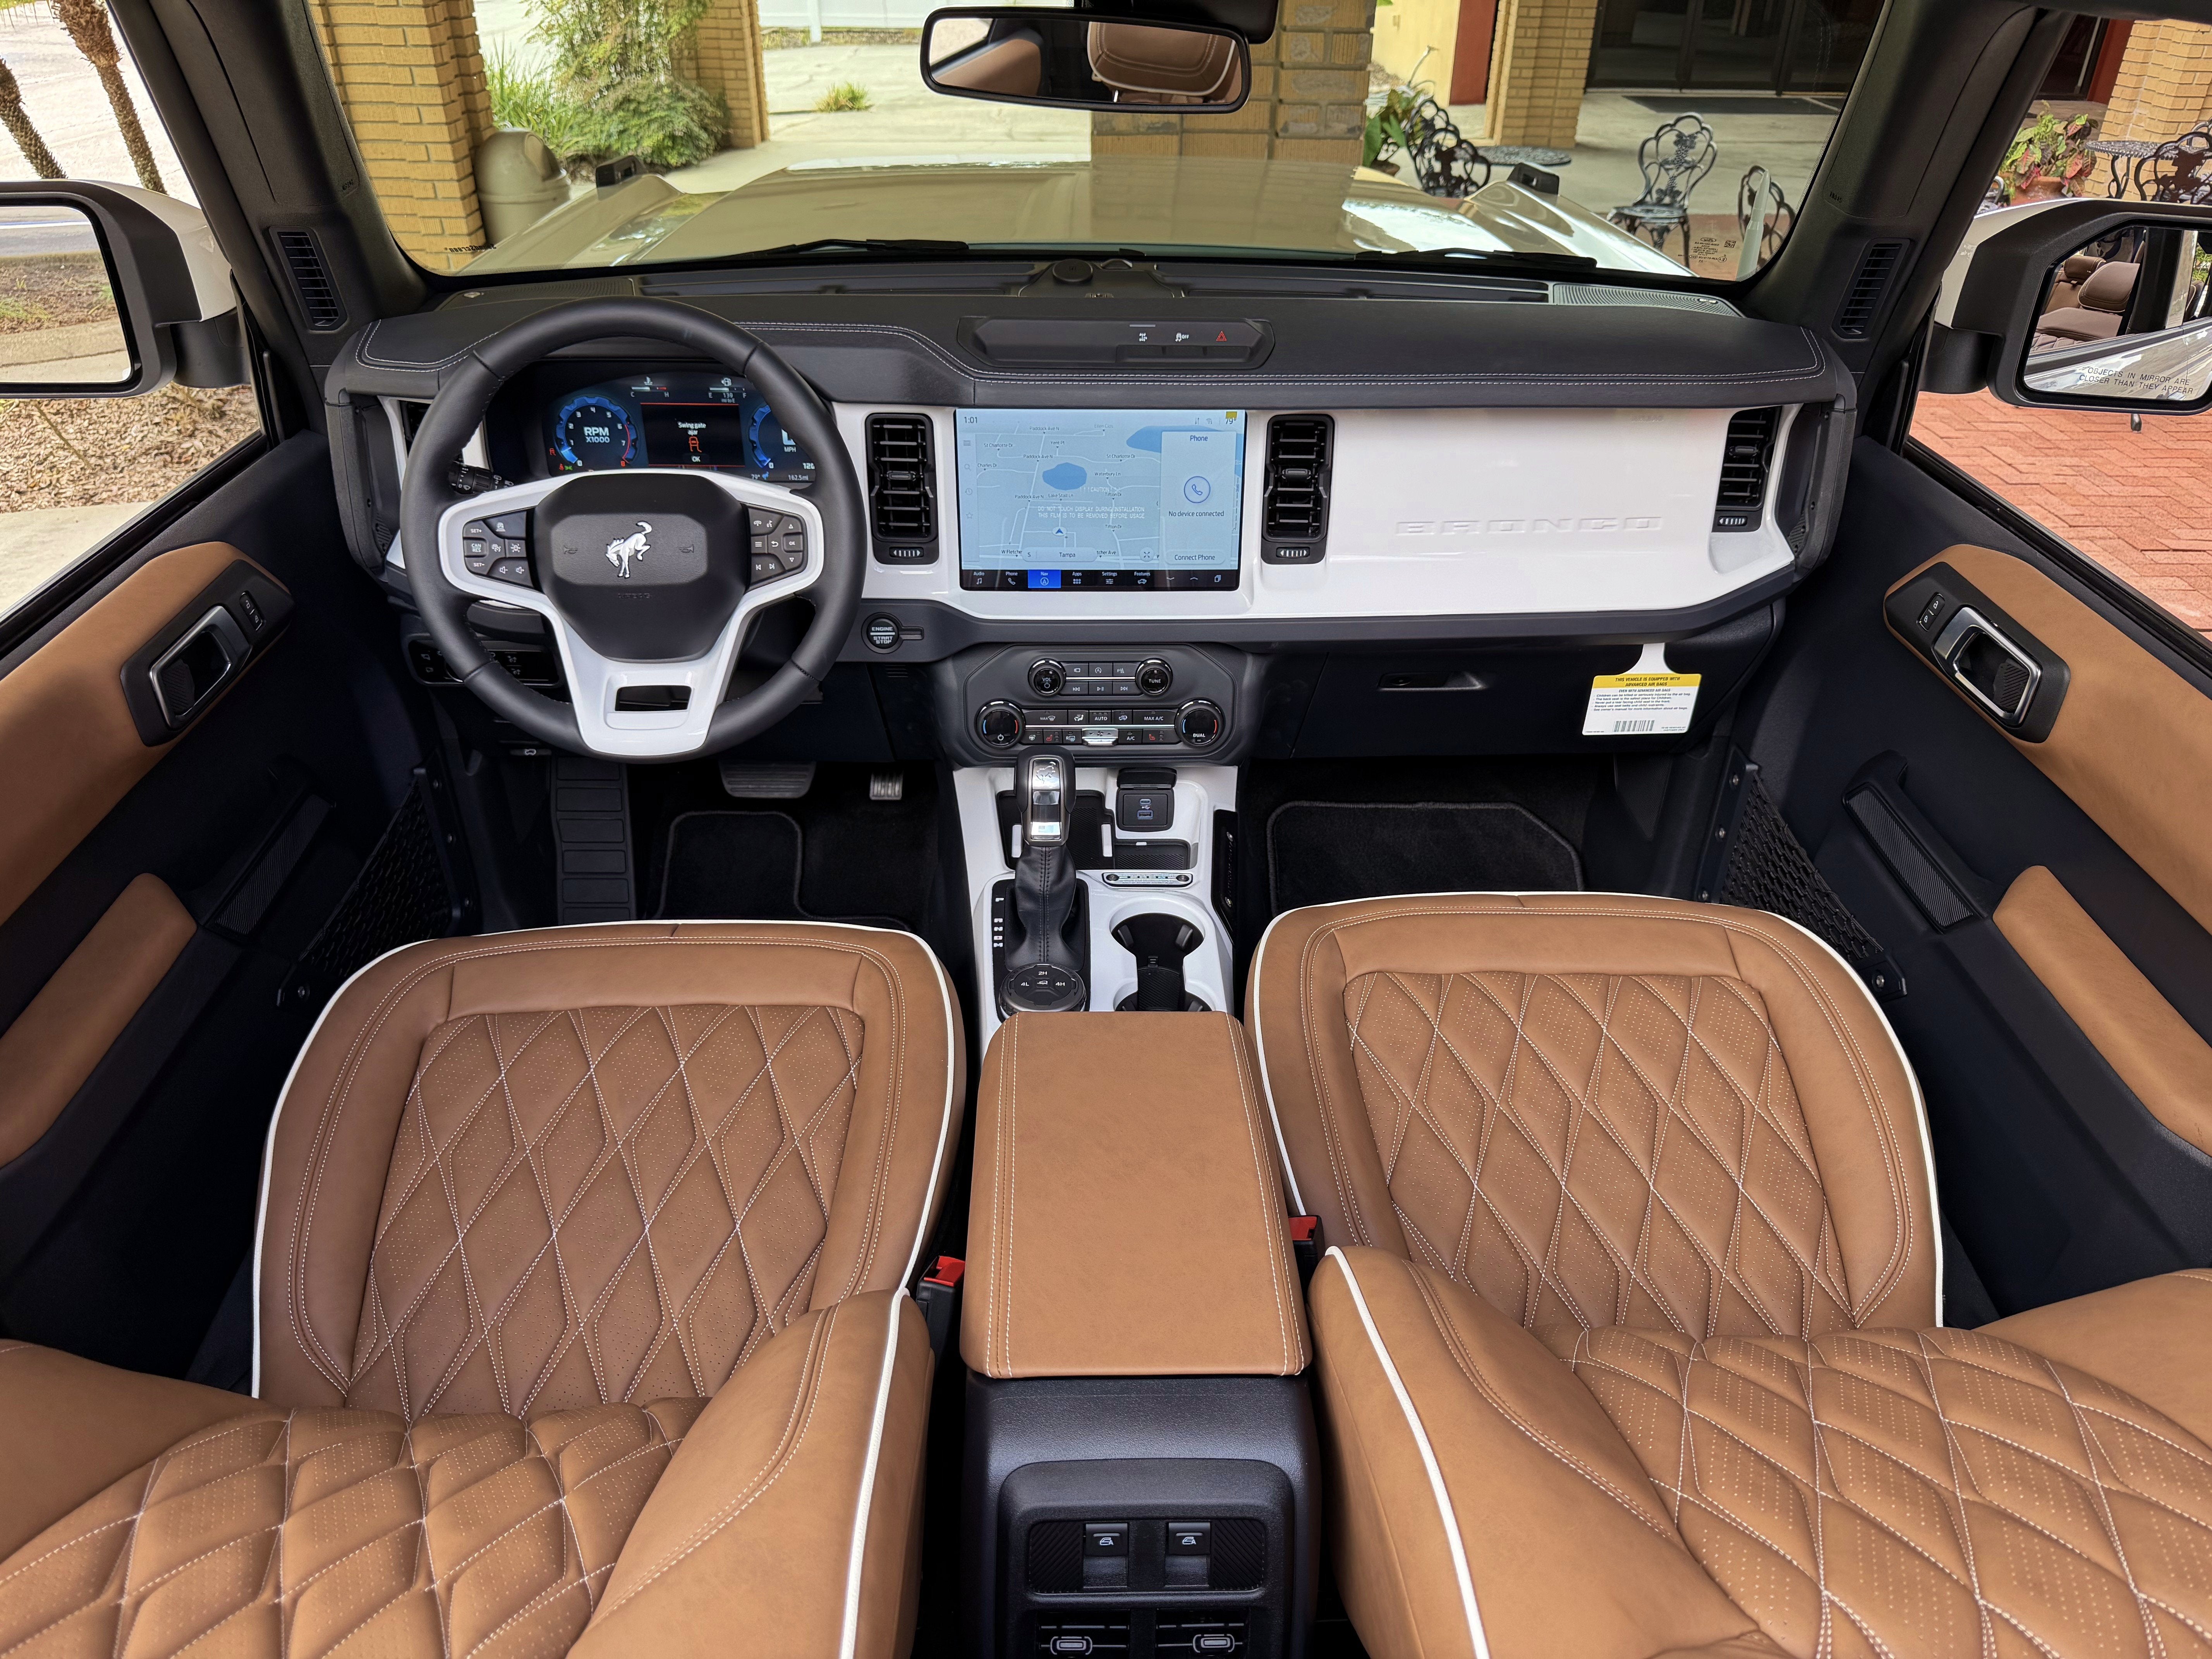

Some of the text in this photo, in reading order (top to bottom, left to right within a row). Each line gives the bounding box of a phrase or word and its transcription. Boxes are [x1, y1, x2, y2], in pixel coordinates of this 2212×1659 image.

[2079, 374, 2194, 394] CLOSER THAN THEY APPEAR
[2088, 367, 2123, 378] OBJECTS
[2140, 374, 2171, 383] MIRROR
[584, 427, 610, 436] RPM
[1395, 516, 1662, 536] BRONCO
